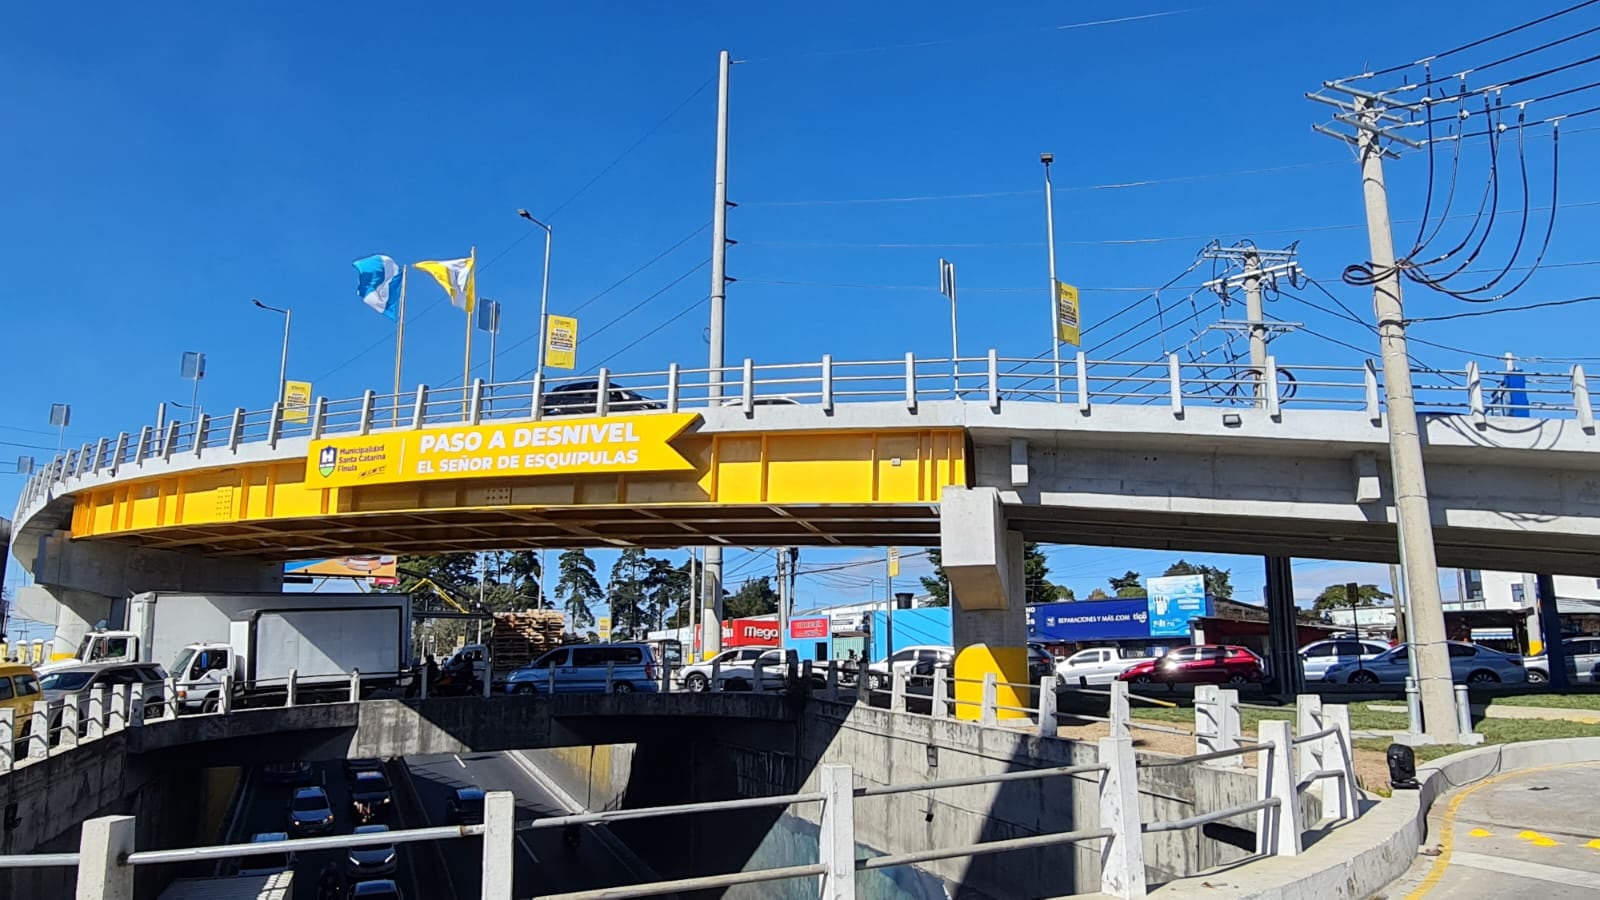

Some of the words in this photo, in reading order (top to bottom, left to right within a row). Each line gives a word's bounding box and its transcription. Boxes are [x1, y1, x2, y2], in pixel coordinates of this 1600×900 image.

[419, 431, 482, 453] PASO
[488, 430, 506, 449] A
[513, 422, 640, 447] DESNIVEL
[340, 444, 385, 455] Municipalidad
[338, 456, 358, 464] Santa
[359, 454, 386, 462] Catarina
[417, 460, 435, 473] EL
[439, 455, 493, 472] SEÑOR
[497, 454, 520, 468] DE
[524, 449, 639, 468] ESQUIPULAS
[1058, 616, 1096, 624] REPARACIONES
